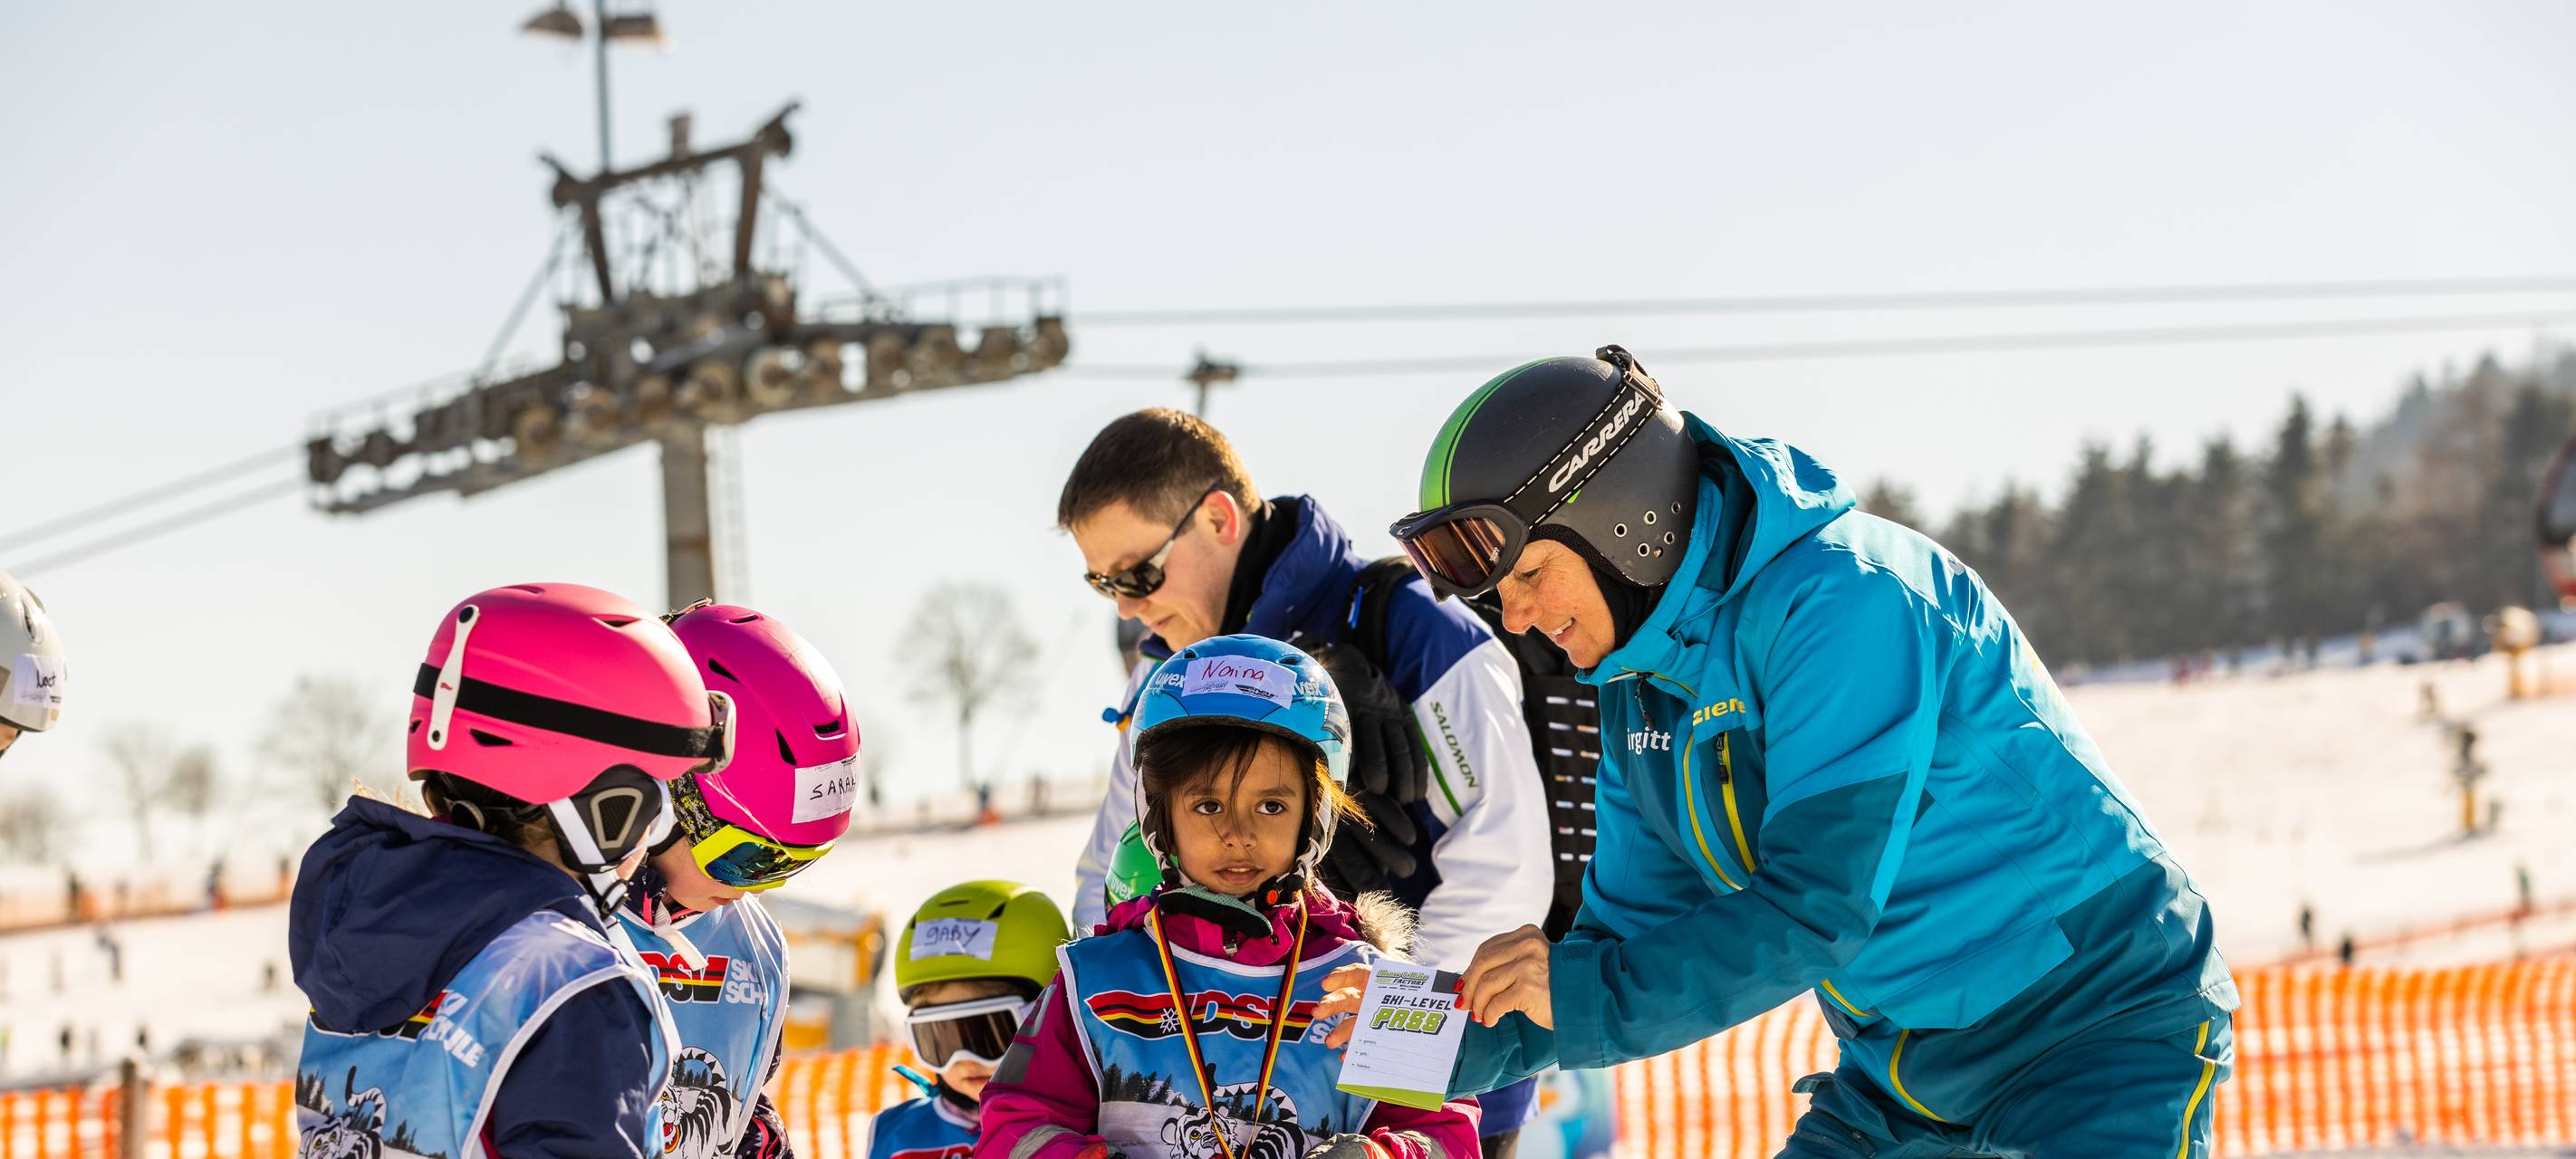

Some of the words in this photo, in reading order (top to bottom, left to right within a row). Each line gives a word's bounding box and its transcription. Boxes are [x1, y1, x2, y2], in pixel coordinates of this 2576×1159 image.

[1548, 390, 1646, 493] CARRERA
[1202, 659, 1265, 682] Naina
[1430, 702, 1478, 788] SALOMON
[1627, 726, 1671, 755] irgitt
[1392, 978, 1427, 986] FACTORY
[1380, 994, 1452, 1011] SKI-LEVEL
[1370, 1005, 1447, 1035] PASS
